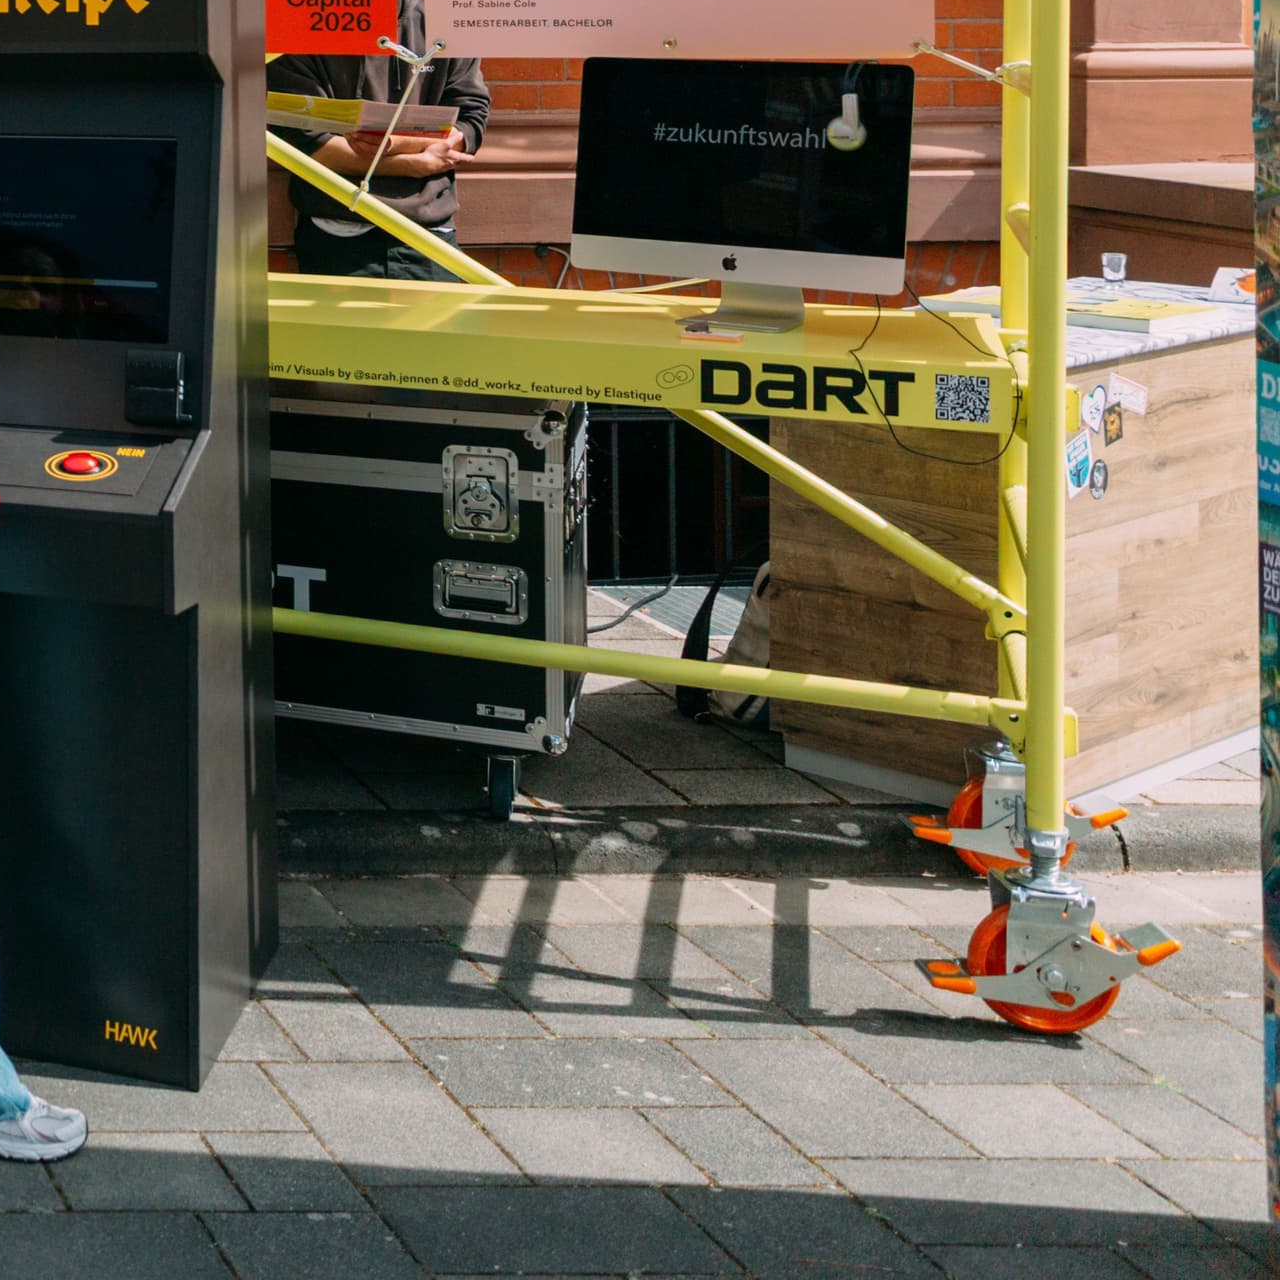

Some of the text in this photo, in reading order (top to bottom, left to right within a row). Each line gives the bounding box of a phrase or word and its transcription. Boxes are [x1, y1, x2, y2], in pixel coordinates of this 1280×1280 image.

[309, 10, 372, 32] 2026
[453, 18, 613, 28] SEMESTERARBEIT, BACHELOR
[653, 122, 828, 149] #zukunftswahl
[293, 364, 662, 403] Visuals by @sarah.jennen @dd_workz_ featured by Elastique
[116, 447, 145, 458] NEIN
[105, 1020, 158, 1050] HAWK
